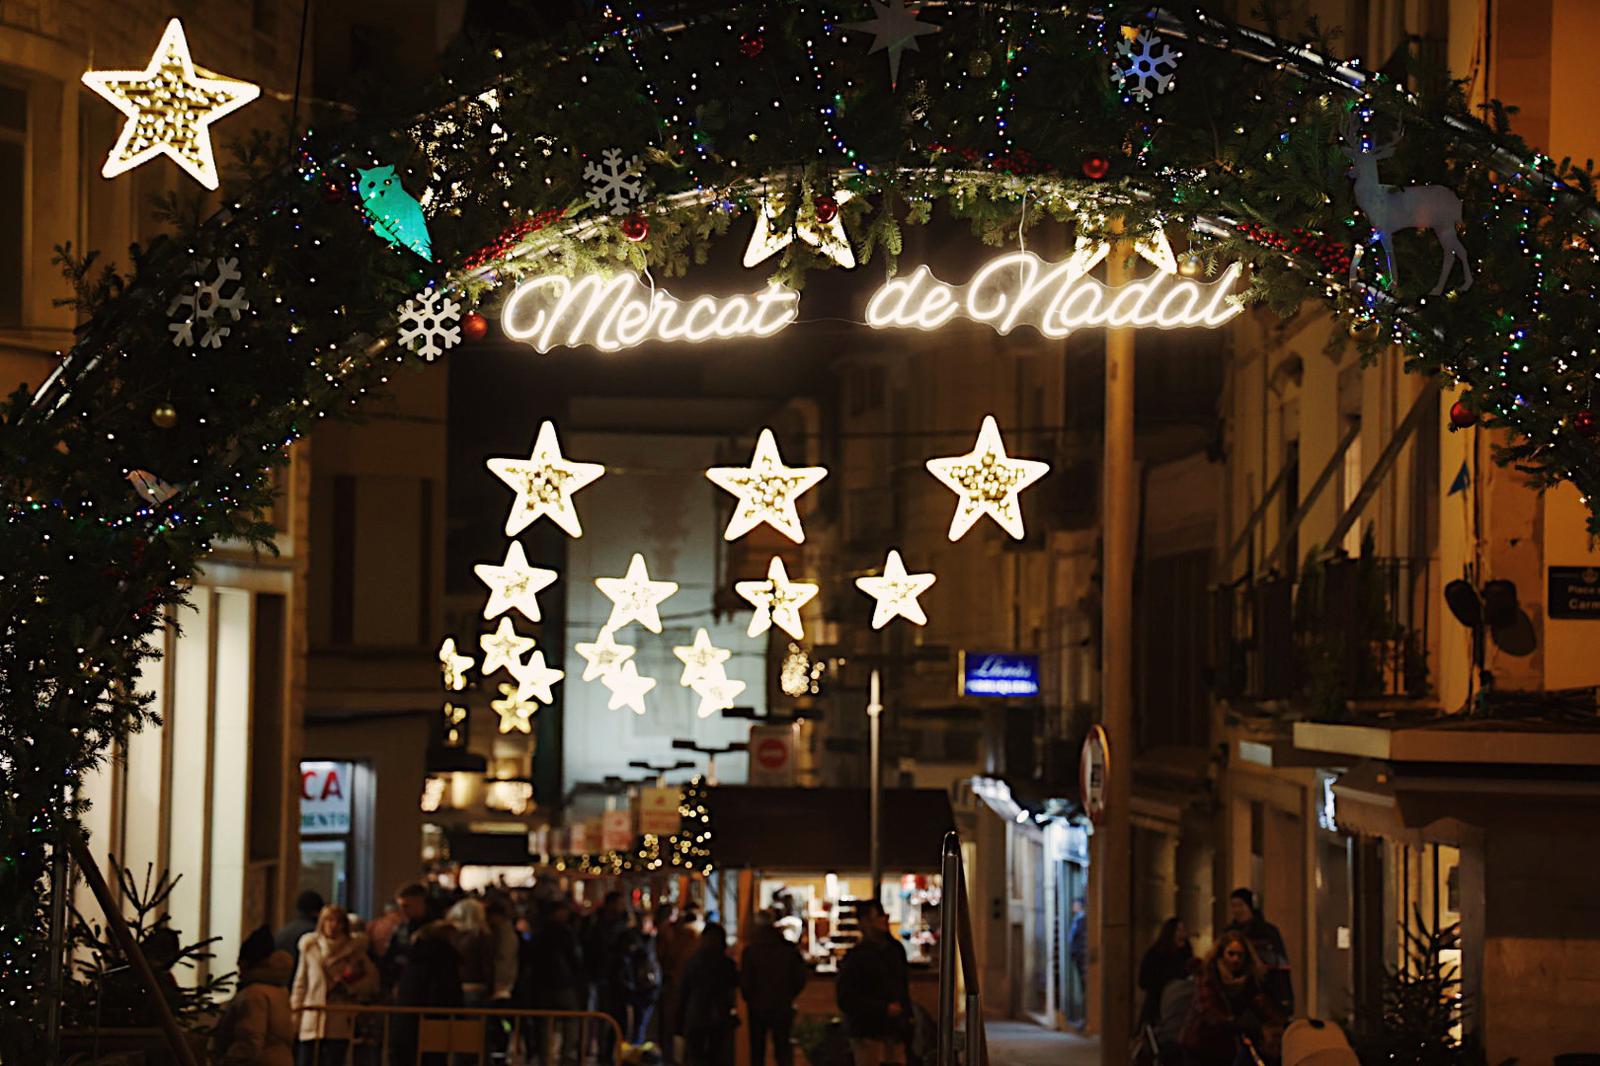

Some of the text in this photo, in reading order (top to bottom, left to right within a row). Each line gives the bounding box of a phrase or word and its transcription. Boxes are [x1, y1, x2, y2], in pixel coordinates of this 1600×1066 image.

[502, 251, 1244, 351] Mercat de Nadal
